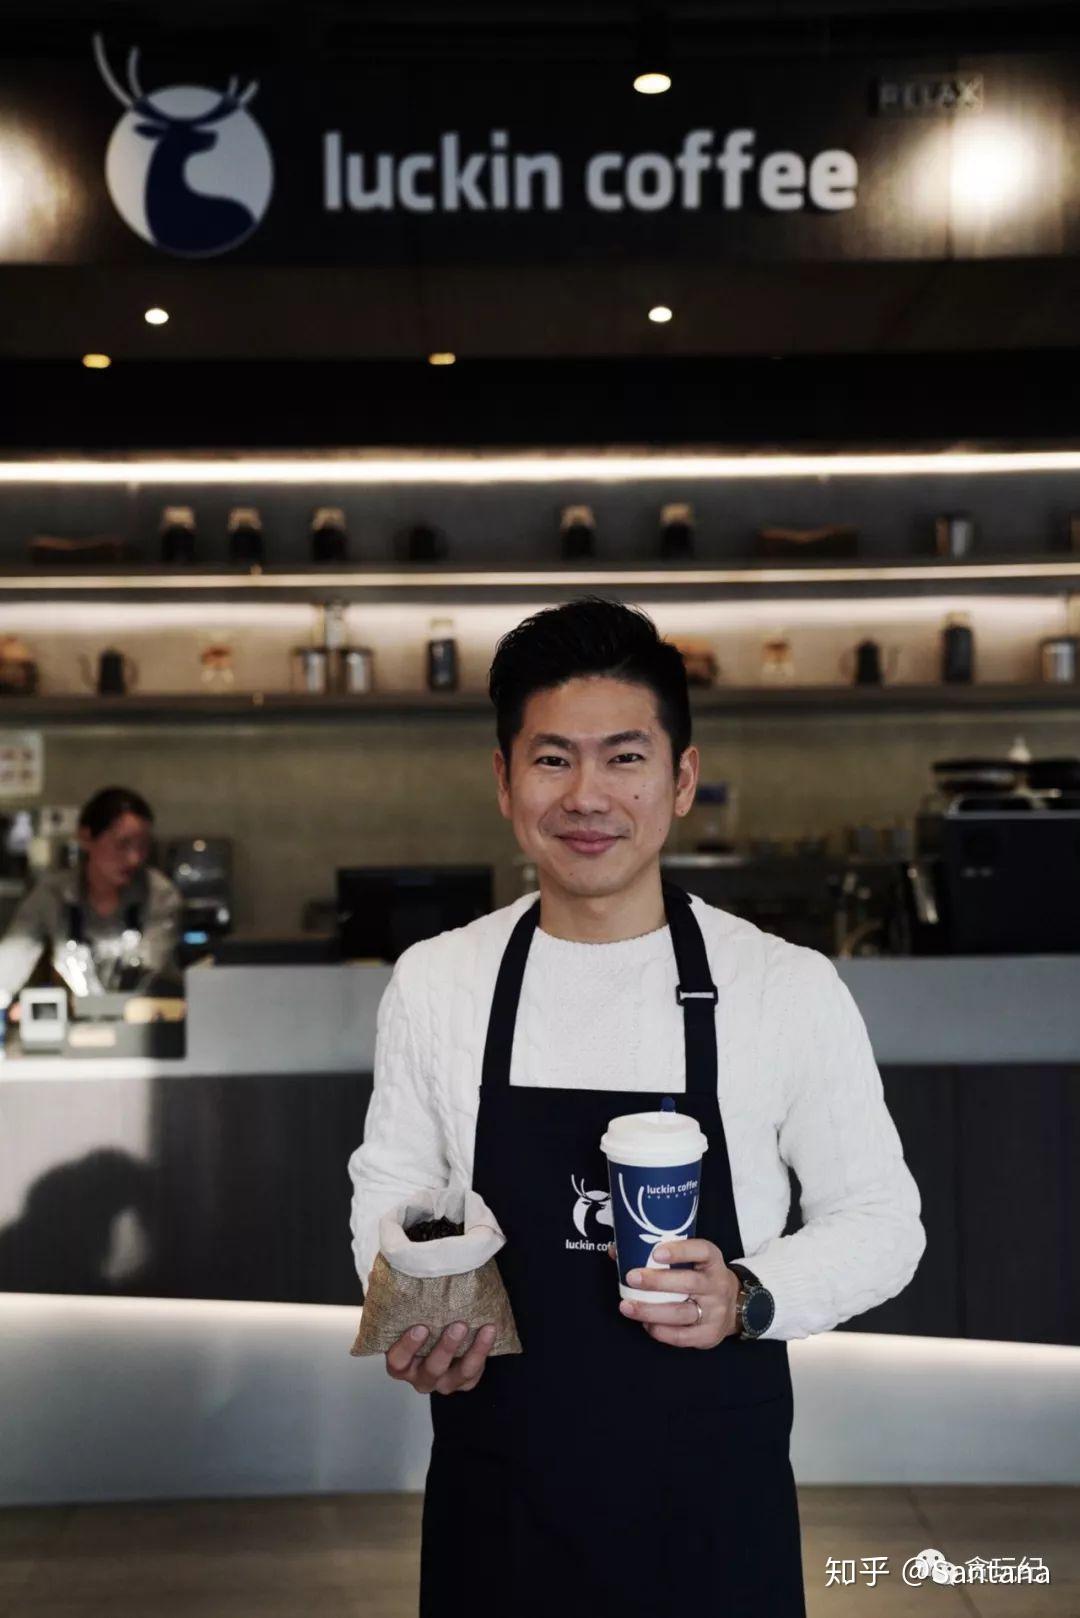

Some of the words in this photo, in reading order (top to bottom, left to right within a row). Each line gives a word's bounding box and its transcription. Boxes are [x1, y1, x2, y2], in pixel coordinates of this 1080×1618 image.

[324, 131, 562, 211] luckin
[586, 130, 858, 211] coffee
[647, 1184, 675, 1195] luckin
[566, 1239, 595, 1251] luckin
